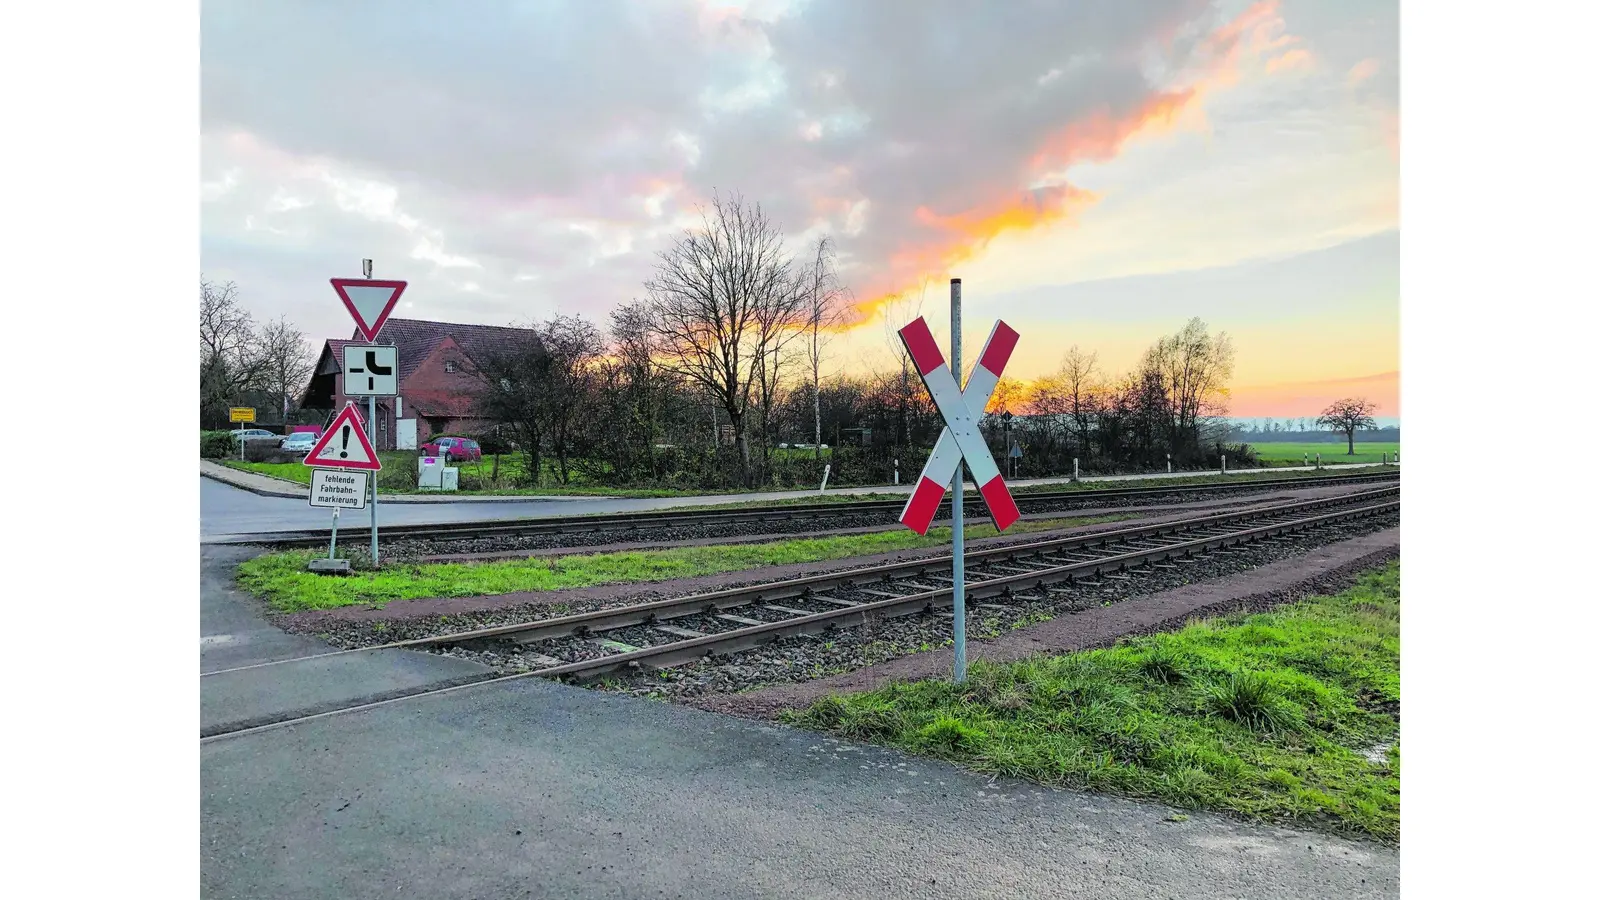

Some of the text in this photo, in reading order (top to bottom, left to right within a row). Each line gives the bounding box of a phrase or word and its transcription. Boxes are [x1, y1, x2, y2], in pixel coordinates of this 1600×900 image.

[325, 475, 355, 484] fehlende
[320, 485, 357, 493] Fahrbahn-
[318, 496, 358, 506] markierung
